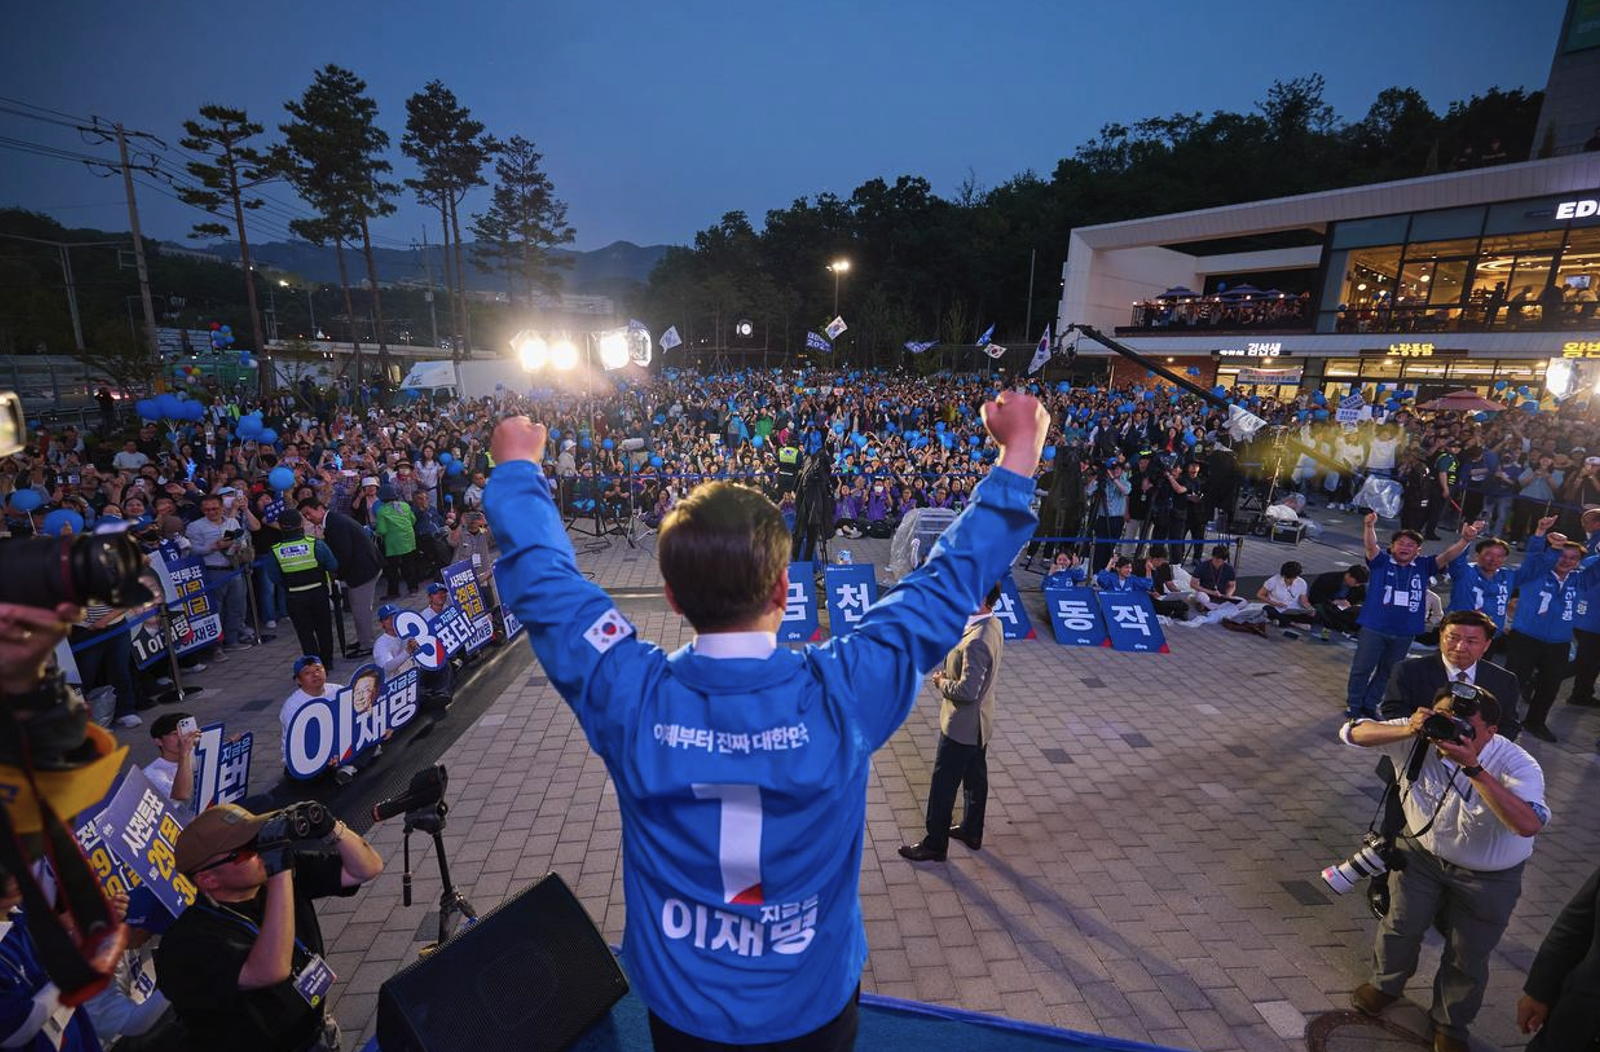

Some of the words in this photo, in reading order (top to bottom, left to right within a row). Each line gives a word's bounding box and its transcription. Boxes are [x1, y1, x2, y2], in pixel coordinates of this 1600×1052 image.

[1247, 342, 1282, 357] 김선생
[836, 583, 871, 622] 천
[1057, 600, 1095, 631] 동
[1111, 605, 1151, 636] 작
[387, 670, 417, 694] 지금은
[289, 682, 417, 775] 이재명
[716, 732, 750, 754] 진짜
[122, 788, 165, 857] 사전투표
[691, 783, 764, 905] 1
[661, 898, 818, 957] 이재명
